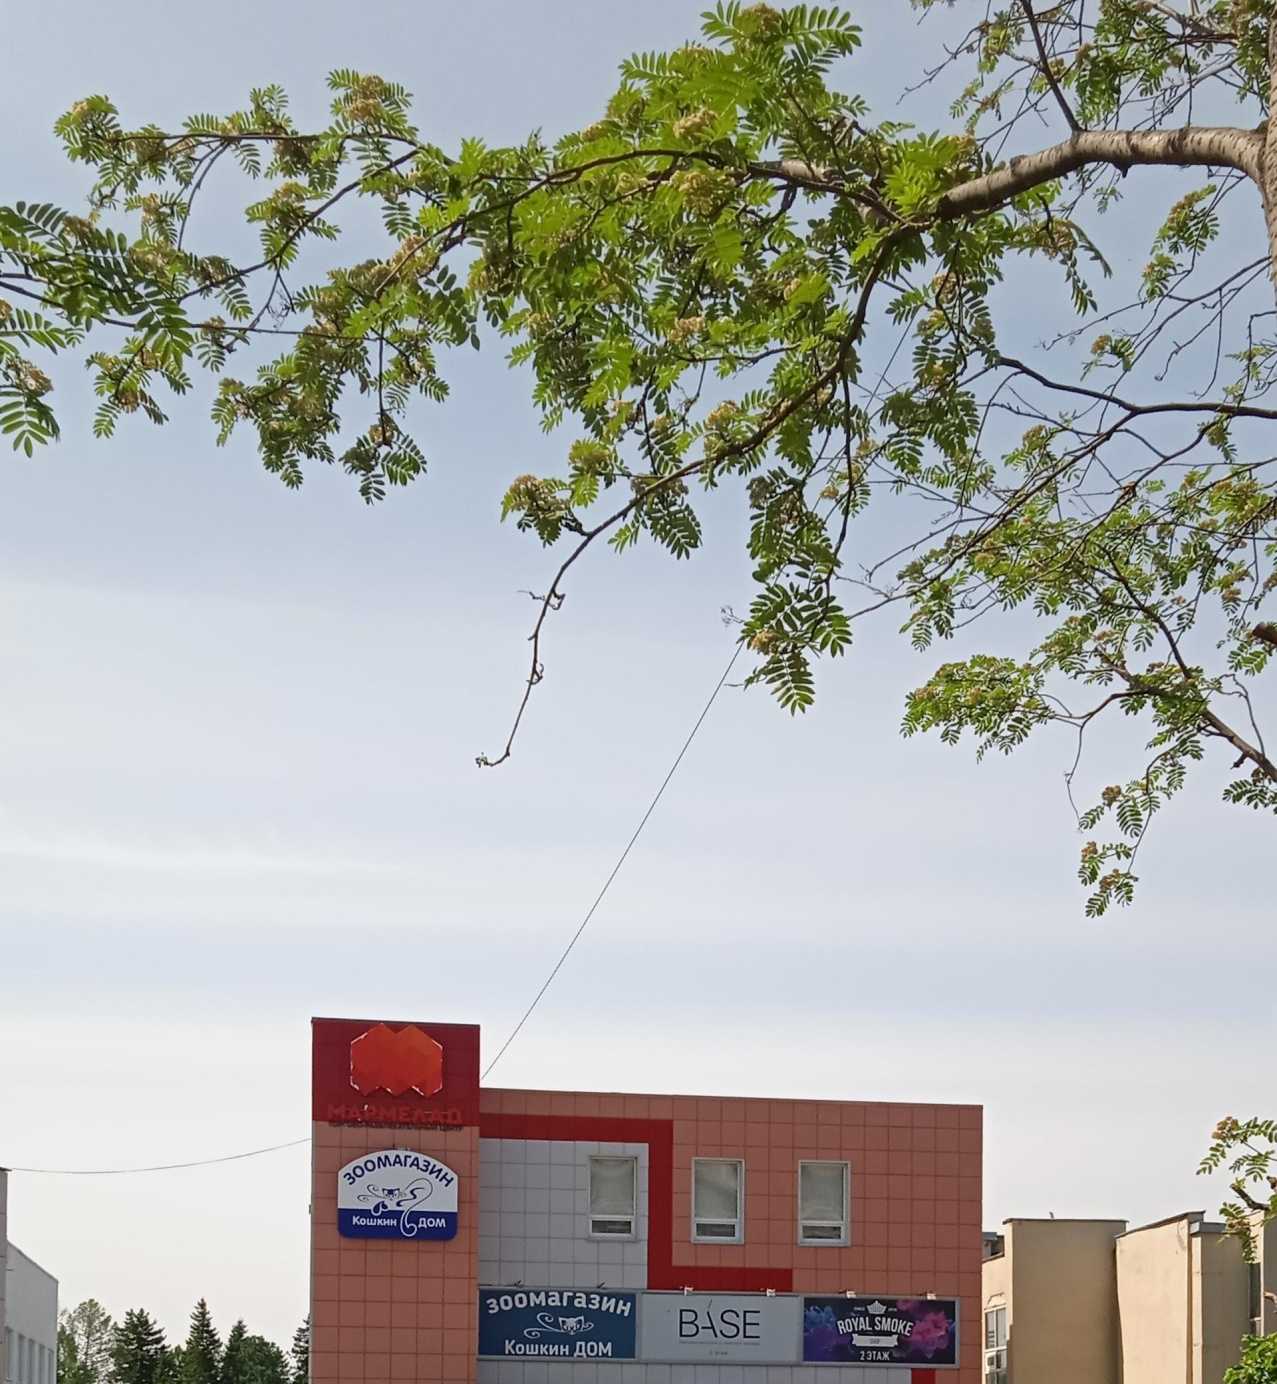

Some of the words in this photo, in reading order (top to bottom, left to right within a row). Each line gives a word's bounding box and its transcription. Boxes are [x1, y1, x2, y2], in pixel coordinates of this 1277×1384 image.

[343, 1154, 455, 1188] ЗООМАГАЗИН
[352, 1215, 397, 1227] Кошкин
[679, 1308, 761, 1339] BASE
[837, 1316, 873, 1335] ROYAL
[874, 1317, 914, 1337] SMOKE
[504, 1339, 570, 1356] Кошкин
[573, 1341, 613, 1359] ДОМ
[860, 1350, 867, 1361] 2
[868, 1351, 891, 1361] ЭТАЖ
